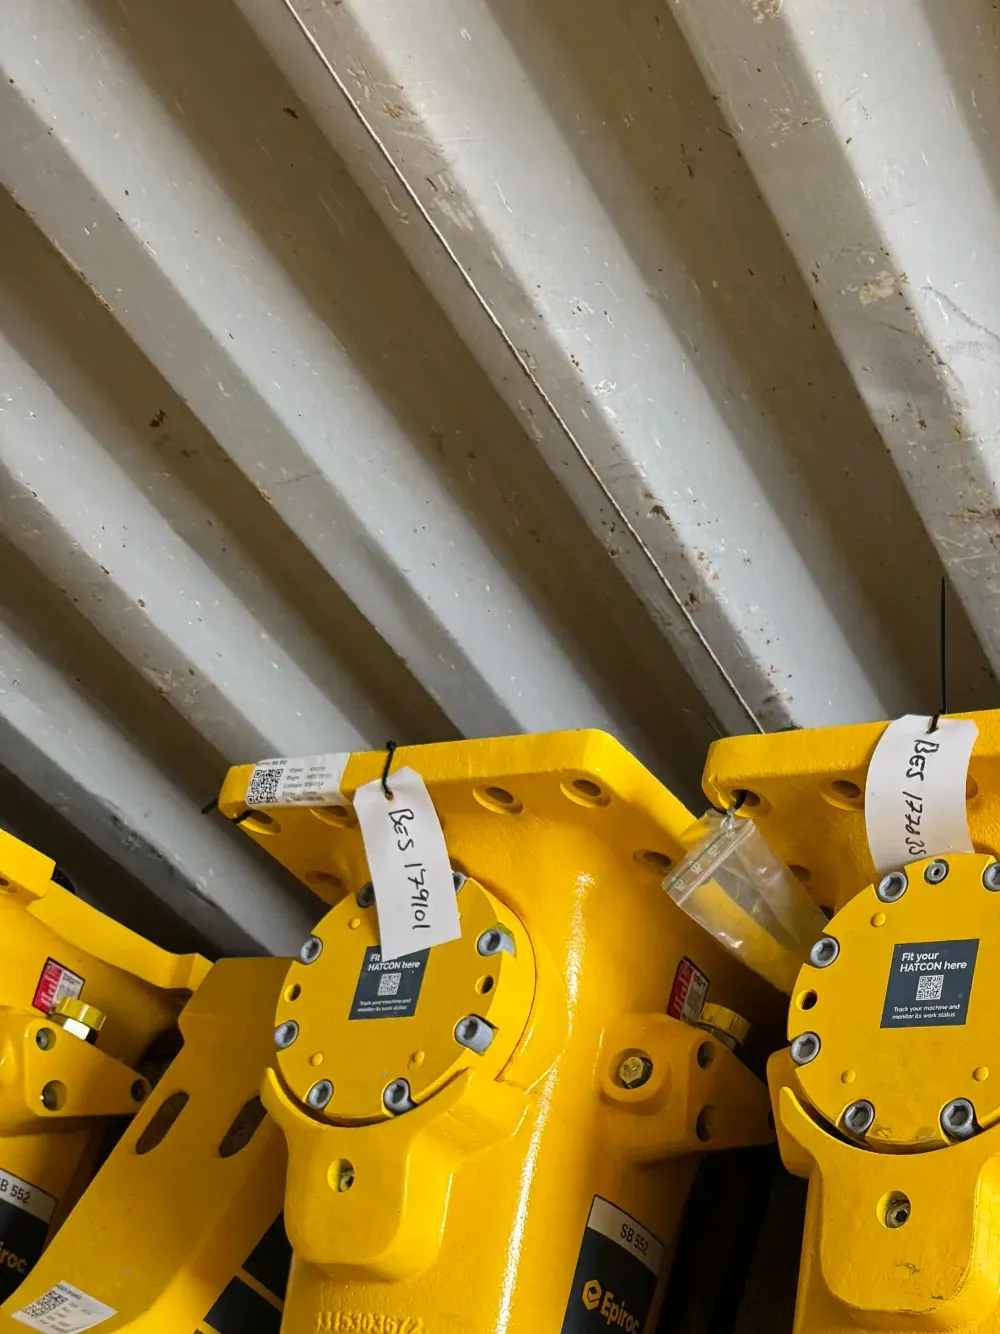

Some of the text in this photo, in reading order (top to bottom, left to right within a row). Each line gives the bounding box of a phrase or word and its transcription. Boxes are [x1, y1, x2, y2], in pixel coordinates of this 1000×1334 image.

[906, 739, 939, 782] BES
[388, 808, 431, 930] BES 179101
[367, 960, 421, 971] HATCON here
[900, 961, 968, 973] HATCON here
[901, 952, 939, 962] Fit your
[0, 1178, 31, 1203] B 552
[620, 1223, 649, 1256] SB 552
